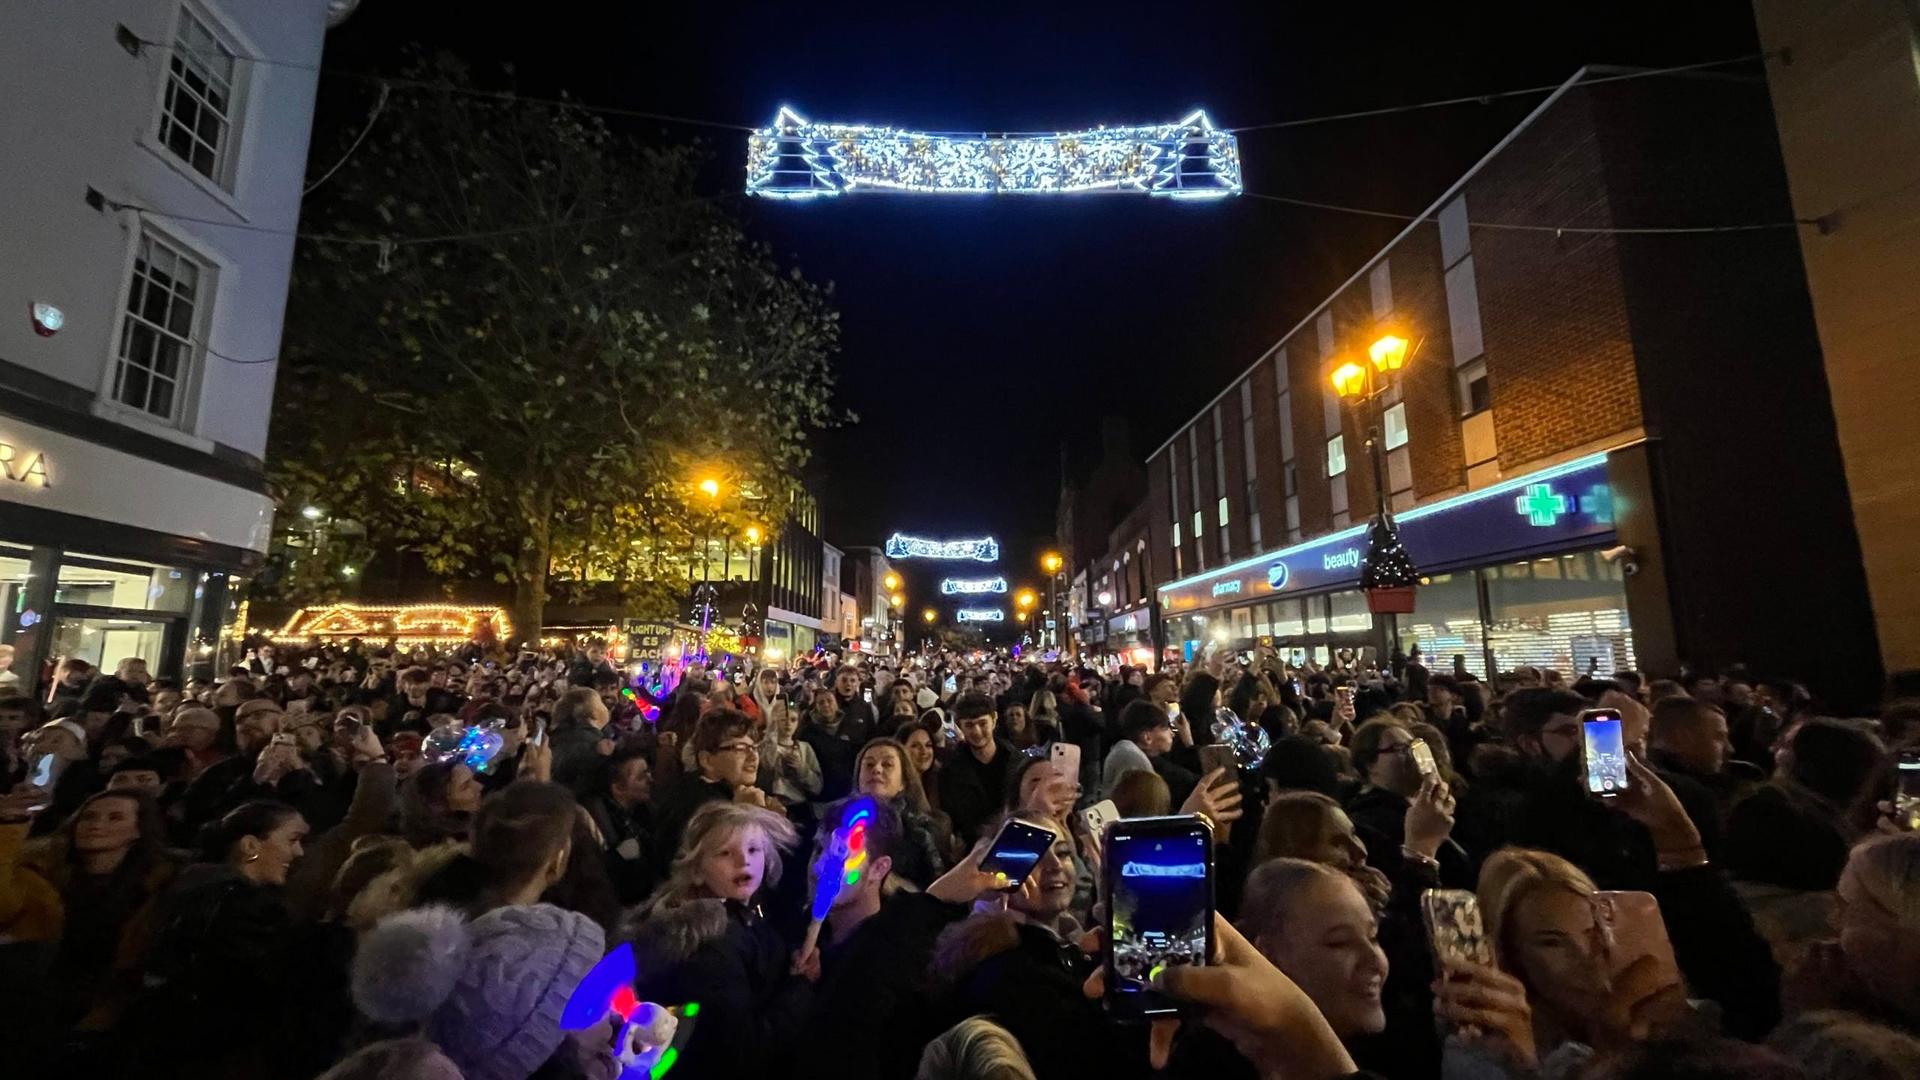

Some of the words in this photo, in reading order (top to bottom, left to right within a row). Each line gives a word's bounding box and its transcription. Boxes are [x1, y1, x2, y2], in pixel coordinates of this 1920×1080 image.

[1324, 547, 1359, 570] beauty
[1212, 579, 1241, 598] pharmacy
[630, 624, 655, 635] LIGHT
[655, 624, 671, 636] UPS
[642, 636, 658, 646] £5
[632, 648, 664, 659] EACH
